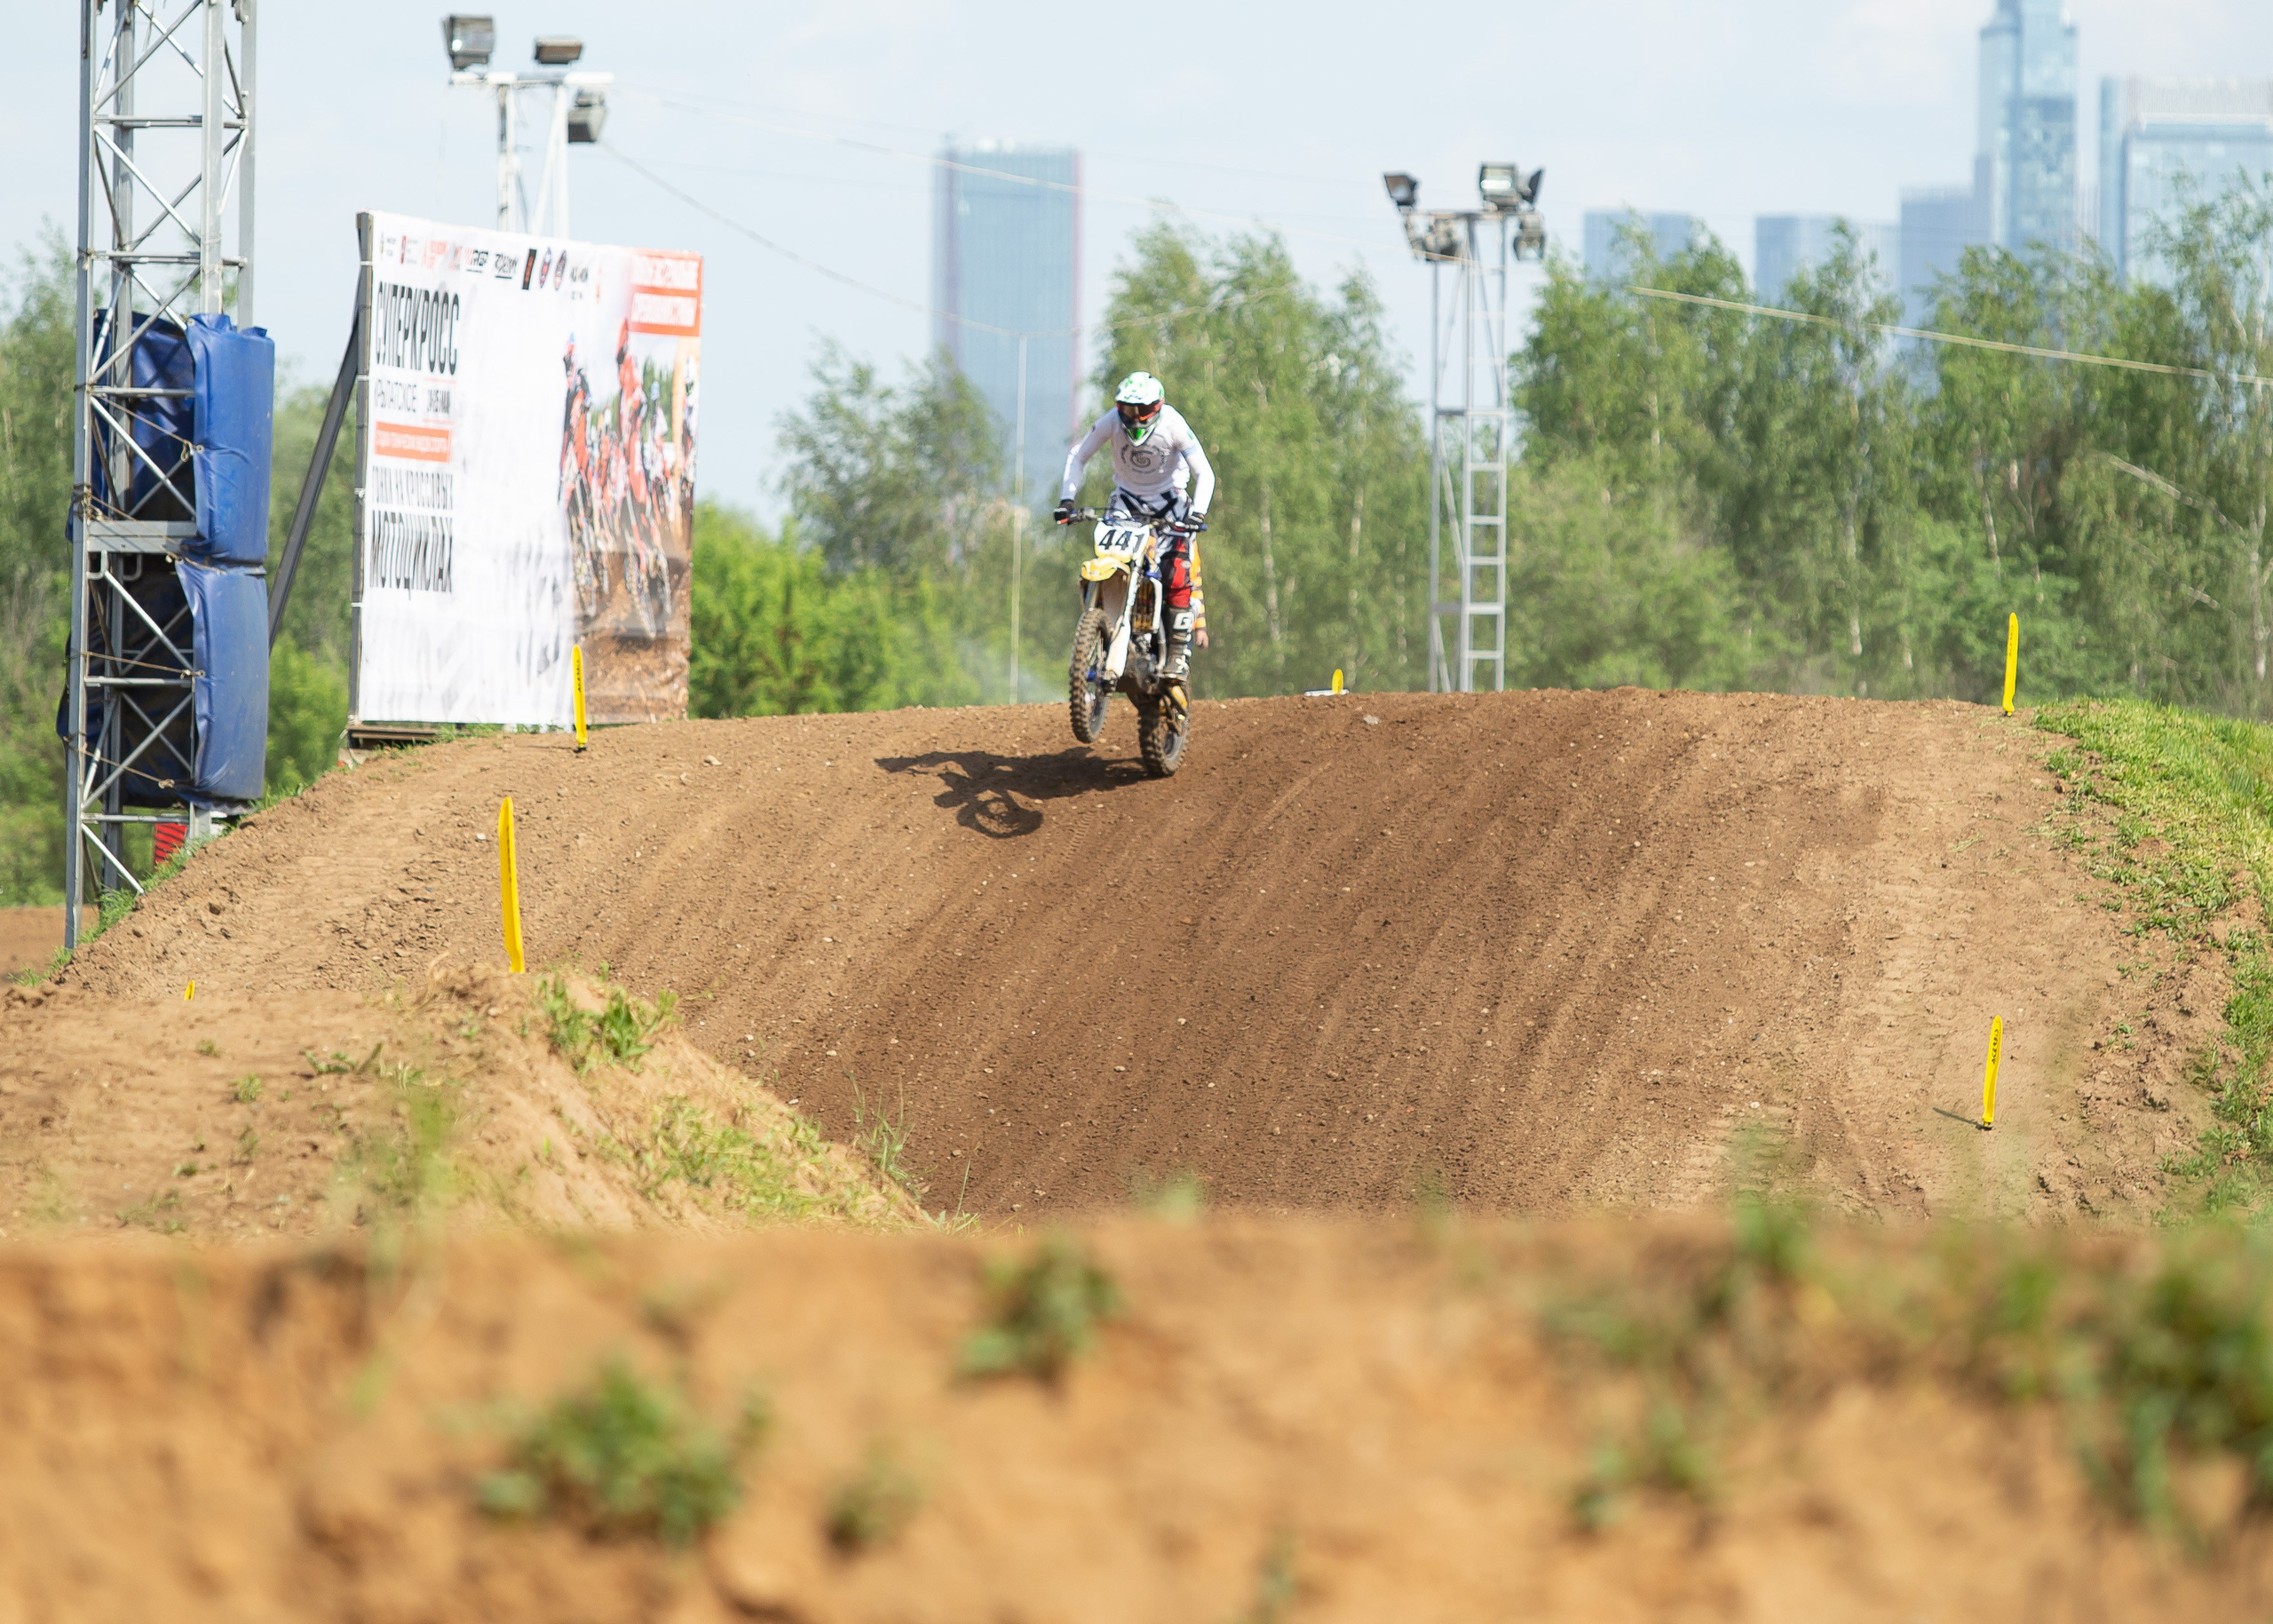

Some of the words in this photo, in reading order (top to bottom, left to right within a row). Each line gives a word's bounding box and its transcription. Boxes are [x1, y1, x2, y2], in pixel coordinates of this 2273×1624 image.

[376, 280, 459, 376] СУПЕРКРОСС
[370, 509, 453, 600] МОТОЦИКЛАХ
[1098, 529, 1145, 553] 441
